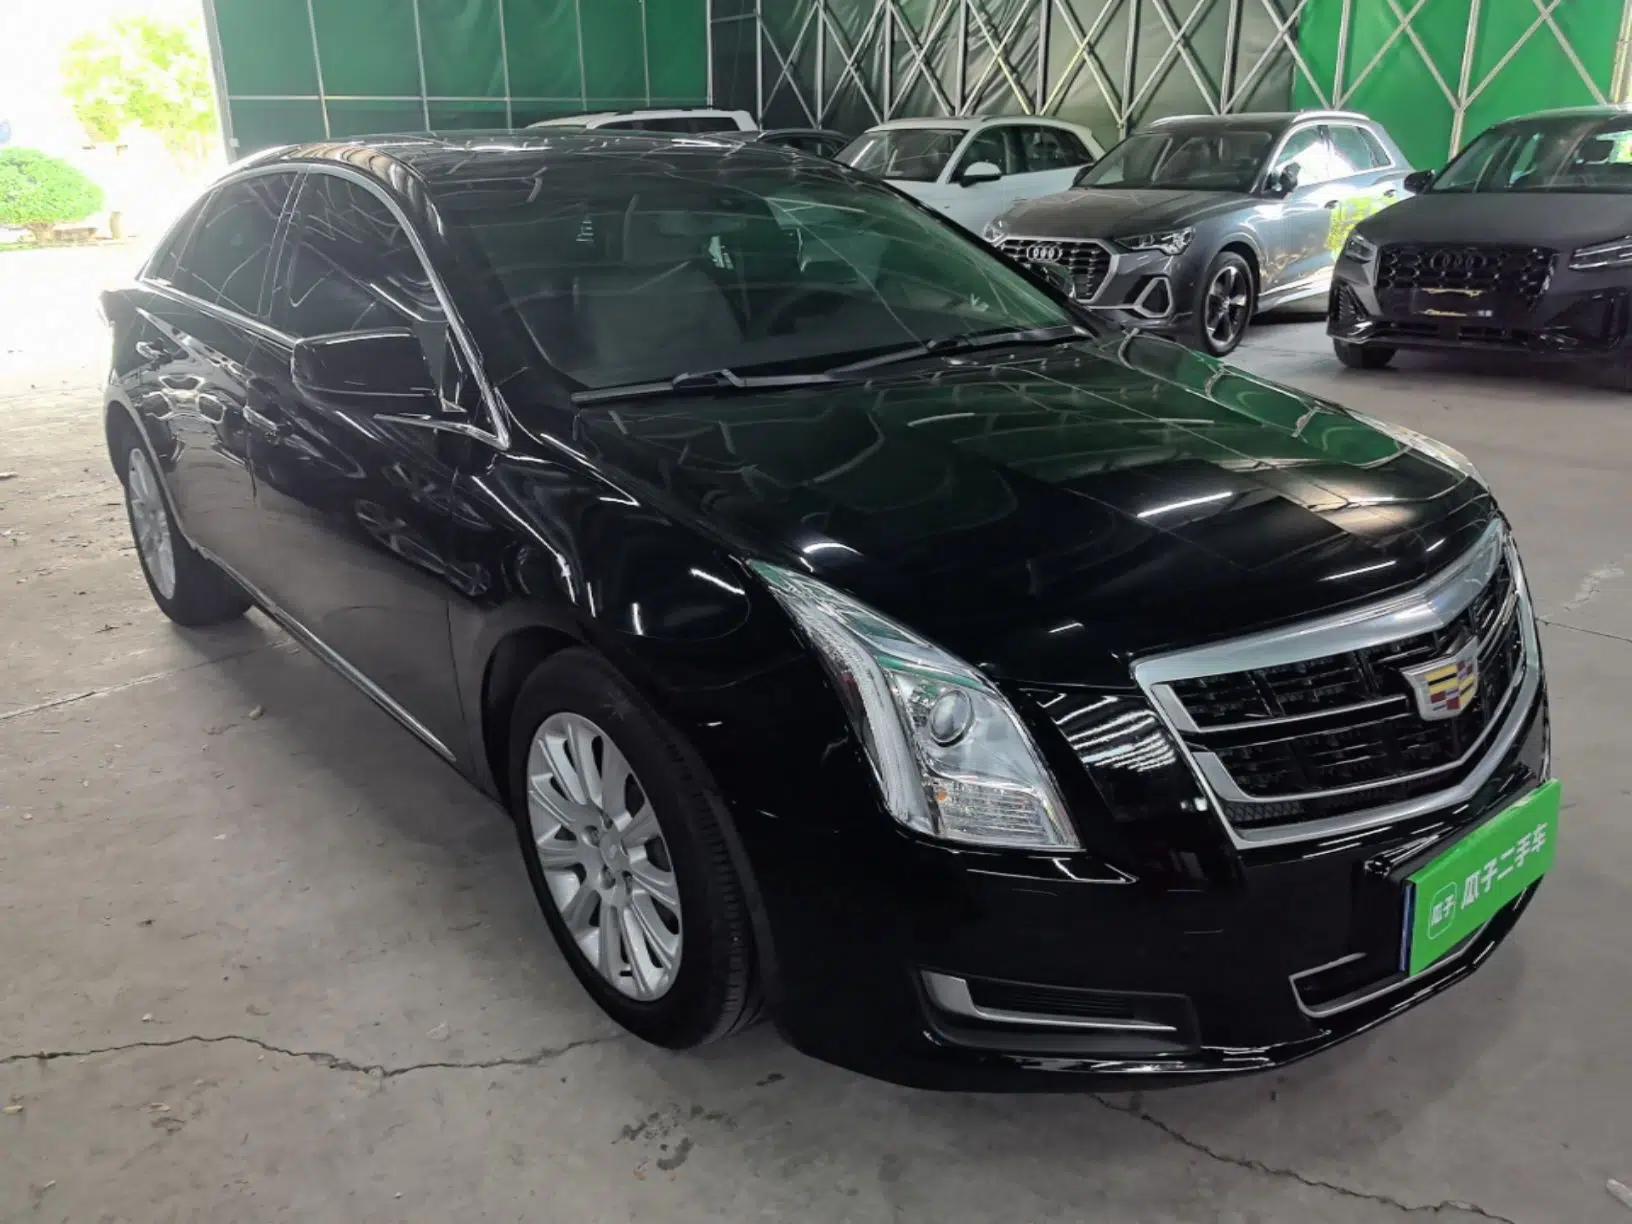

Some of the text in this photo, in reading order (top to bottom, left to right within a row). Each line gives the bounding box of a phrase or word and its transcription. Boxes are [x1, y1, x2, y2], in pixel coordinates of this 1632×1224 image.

[1461, 822, 1548, 910] 瓜子二手车
